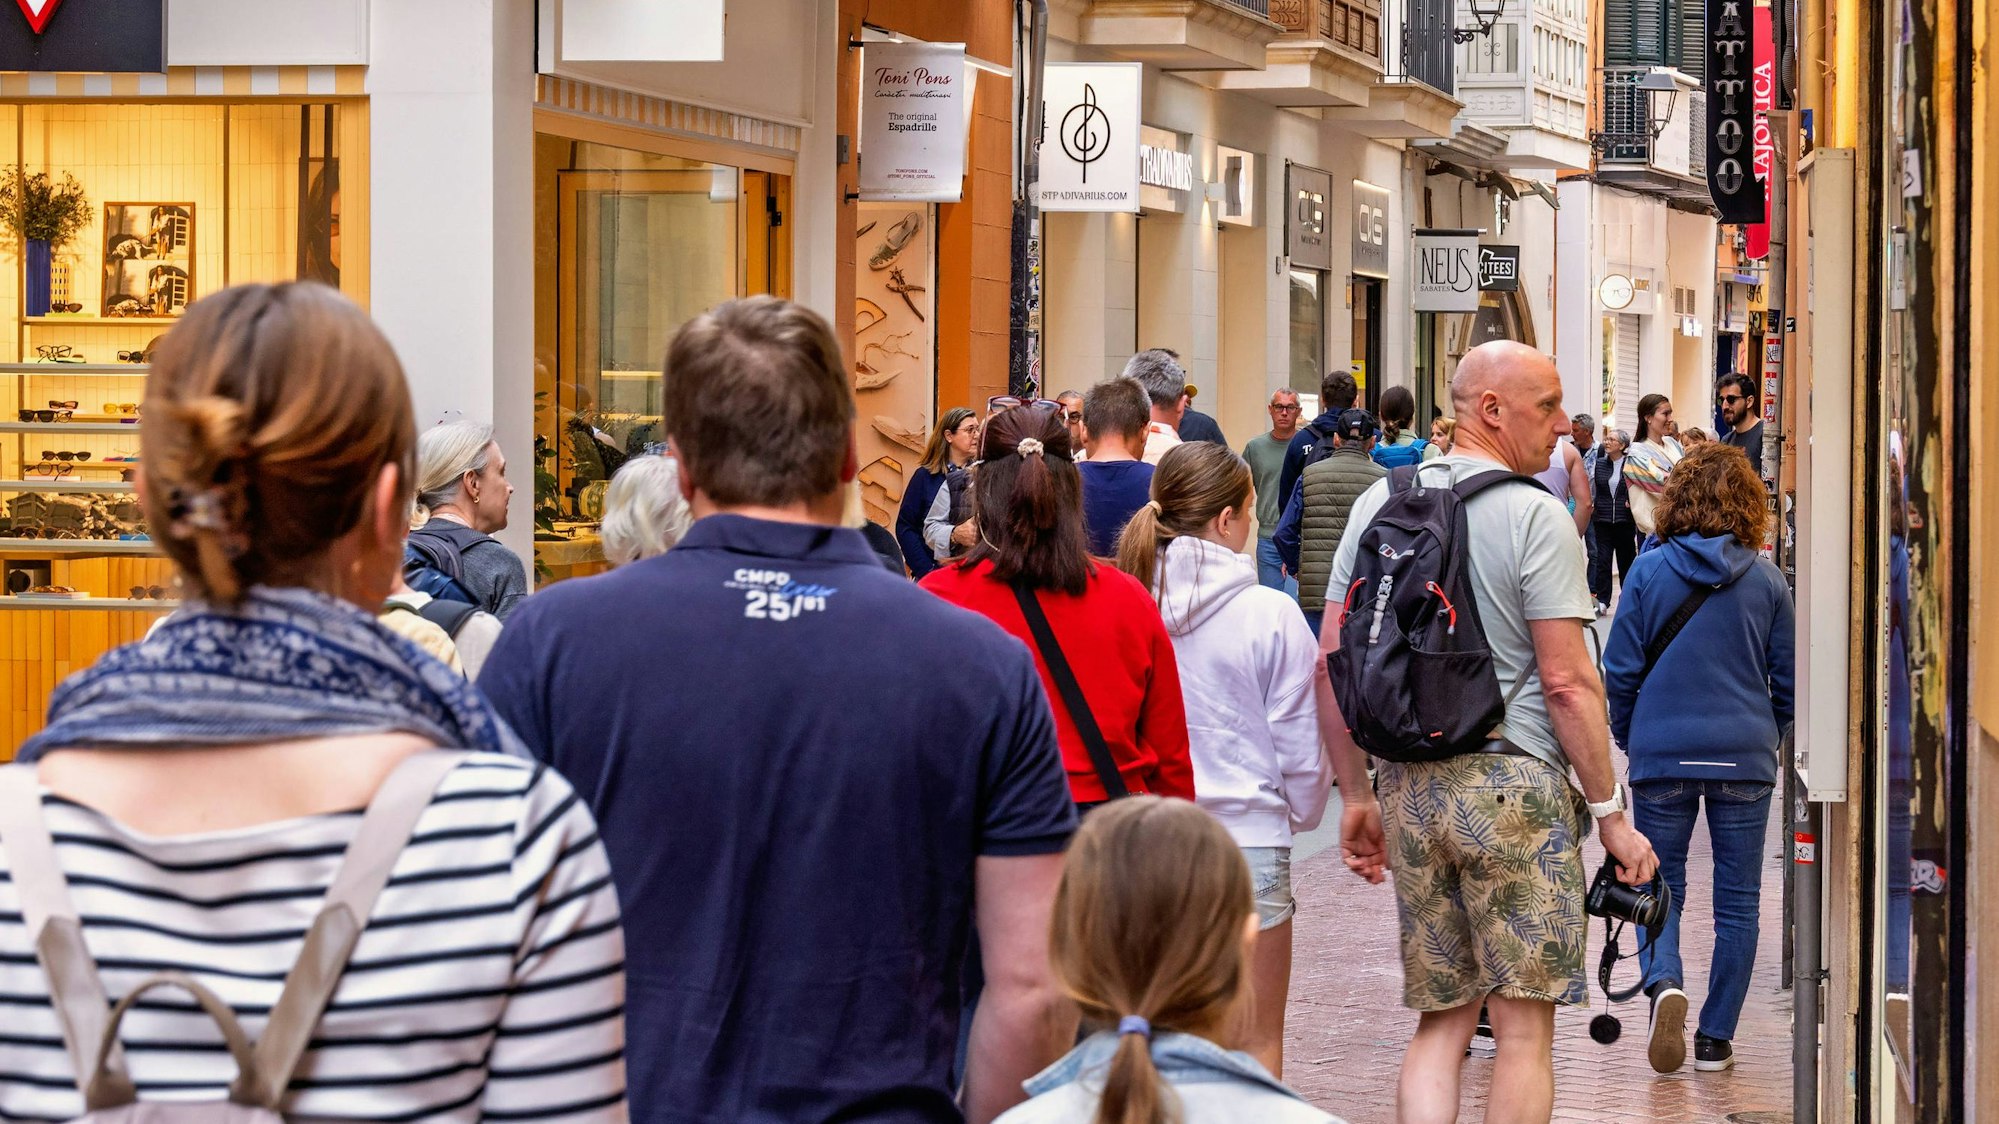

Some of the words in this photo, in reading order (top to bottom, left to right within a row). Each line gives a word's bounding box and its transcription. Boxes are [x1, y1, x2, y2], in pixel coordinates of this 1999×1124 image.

[875, 67, 909, 87] Toni
[914, 67, 952, 87] Pons
[888, 112, 904, 121] The
[906, 112, 937, 123] original
[888, 122, 937, 133] Espadrille
[1139, 144, 1192, 191] TRADIVARIUS
[1421, 248, 1473, 293] NEUS
